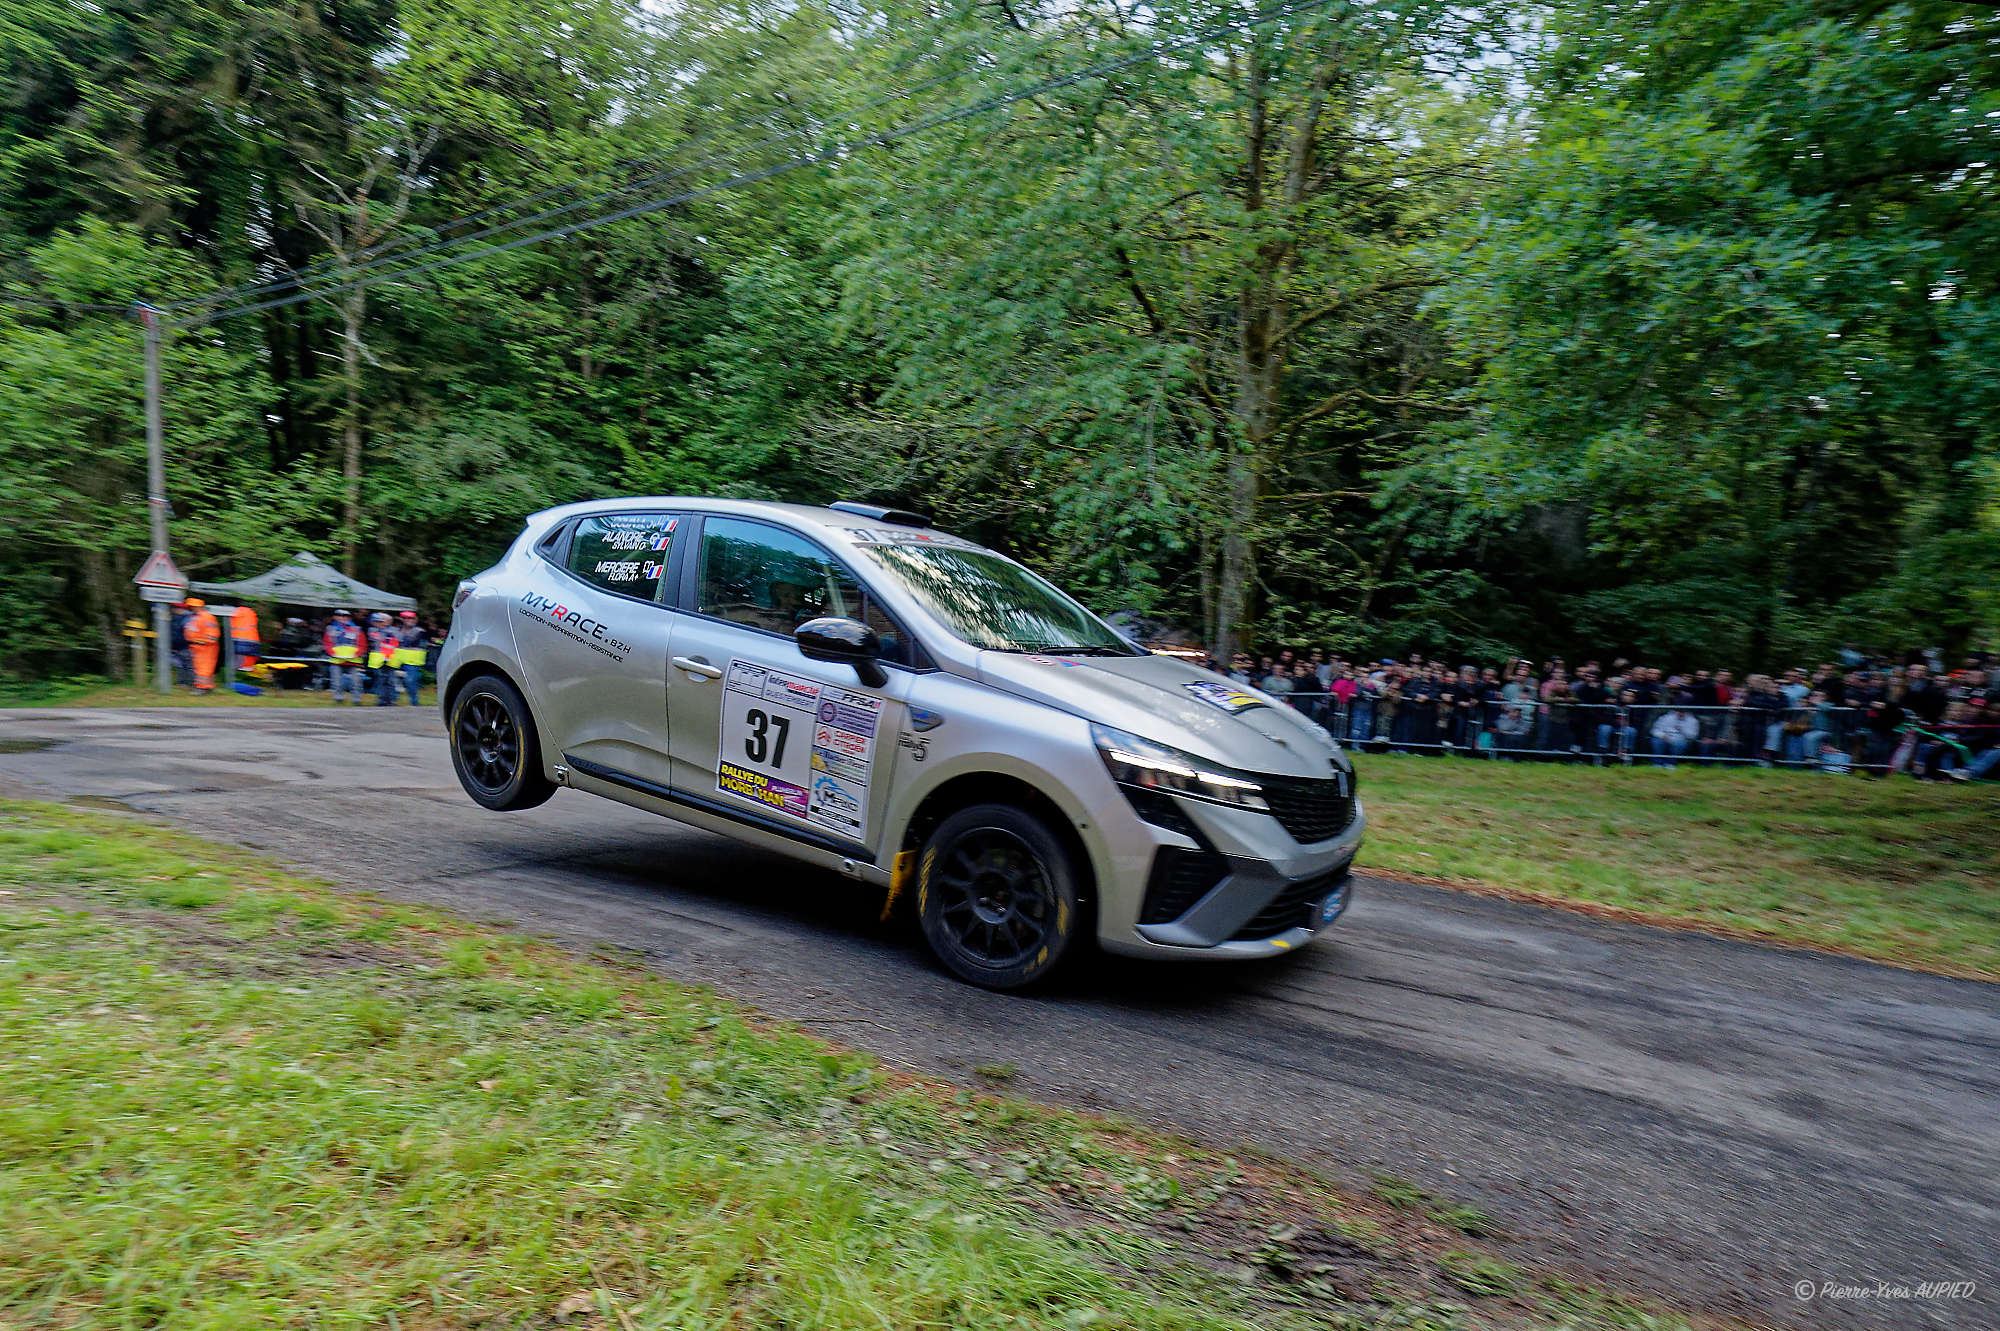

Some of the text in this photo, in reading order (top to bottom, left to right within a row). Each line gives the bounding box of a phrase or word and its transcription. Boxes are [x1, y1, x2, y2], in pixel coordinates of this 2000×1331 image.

[745, 708, 790, 769] 37
[721, 764, 769, 787] RALLYE DU
